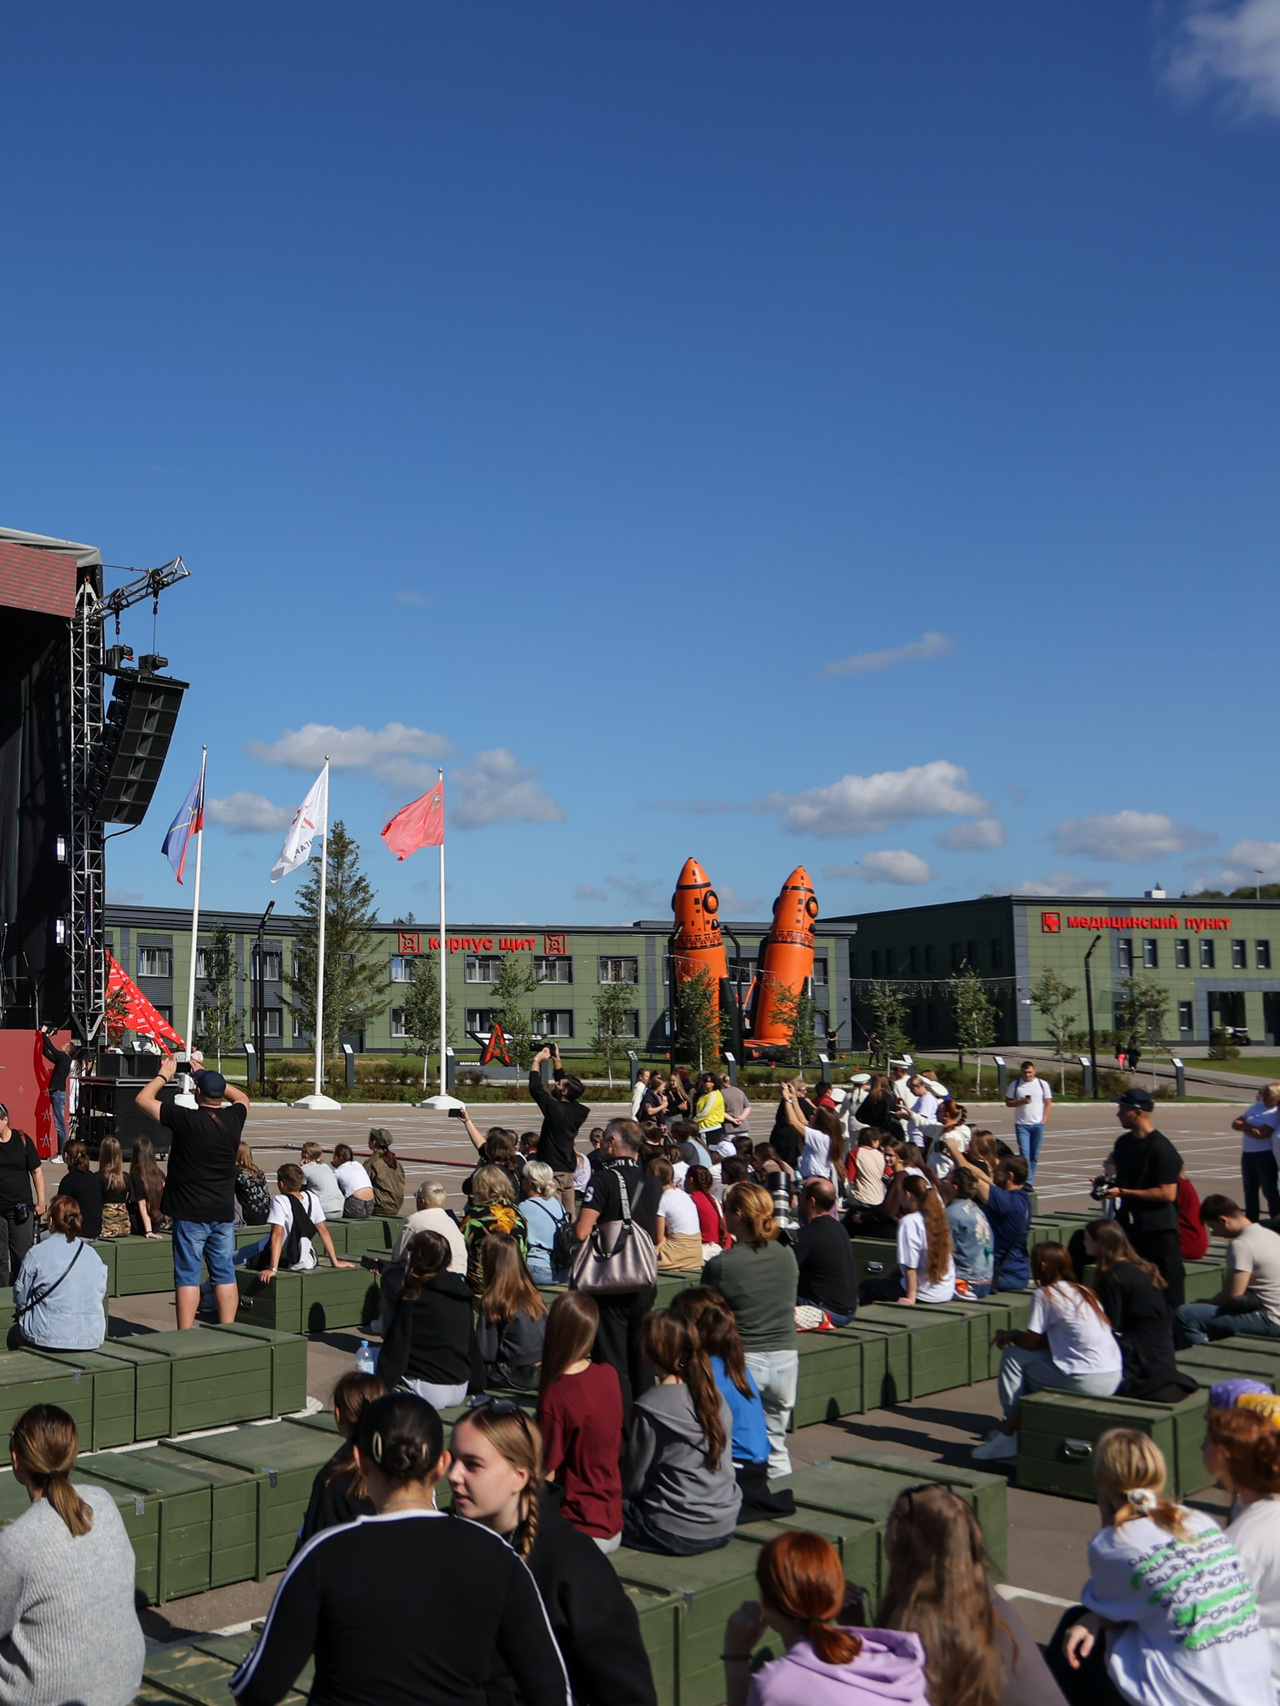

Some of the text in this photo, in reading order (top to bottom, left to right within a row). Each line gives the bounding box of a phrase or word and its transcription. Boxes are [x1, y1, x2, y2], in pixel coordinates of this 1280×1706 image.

[1067, 914, 1232, 933] медицинский пункт
[428, 937, 536, 954] корпус щит
